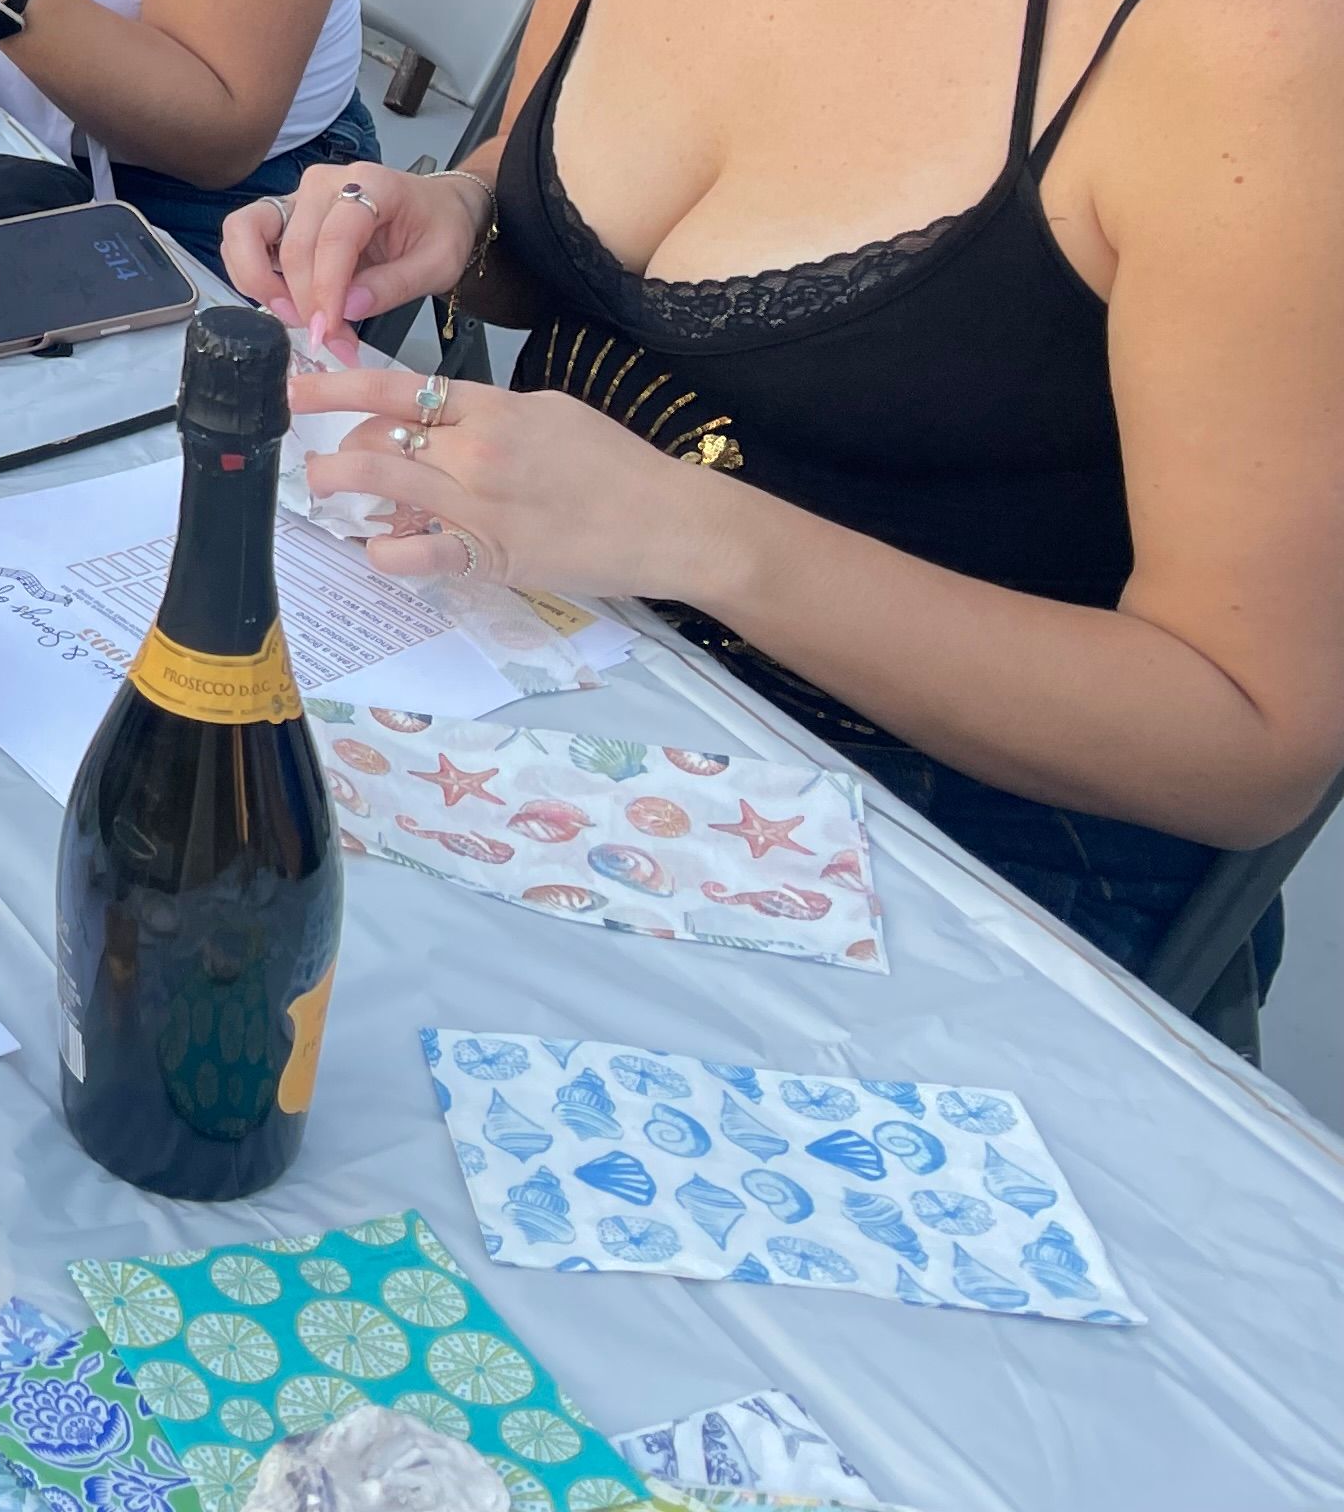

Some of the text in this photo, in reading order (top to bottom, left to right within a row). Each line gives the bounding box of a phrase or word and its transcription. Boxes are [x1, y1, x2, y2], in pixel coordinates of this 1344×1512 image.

[94, 240, 139, 280] 5:14
[366, 574, 395, 591] Alone
[328, 590, 344, 601] Do
[395, 590, 414, 603] Not
[342, 598, 360, 611] We
[375, 600, 413, 622] Around
[360, 609, 383, 624] How
[11, 605, 76, 647] Songs
[325, 609, 394, 651] Another Night
[295, 611, 375, 661] On Bended Knee
[299, 633, 323, 648] Bow
[393, 629, 414, 643] This
[61, 645, 89, 660] &
[294, 650, 335, 679] Fantasy
[330, 654, 356, 669] Take
[163, 667, 235, 696] PROSECCO
